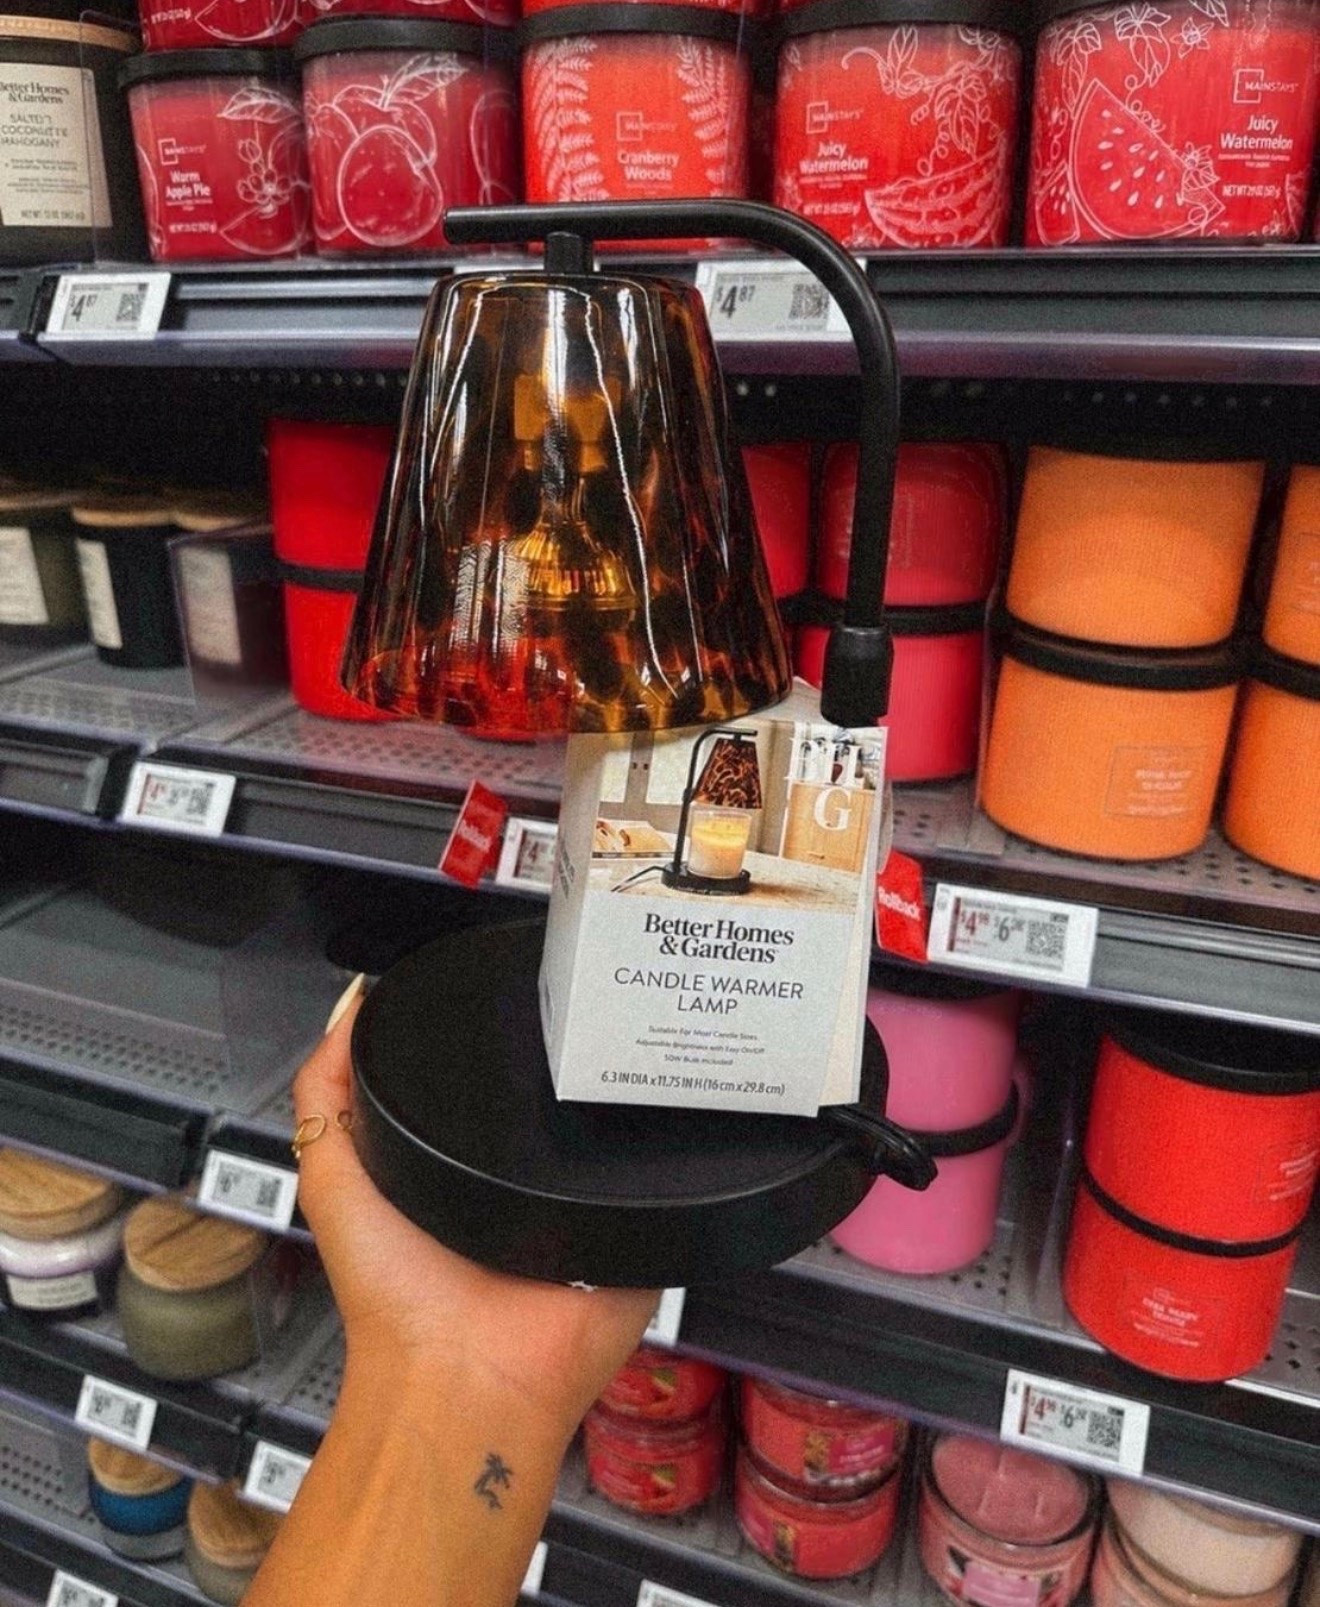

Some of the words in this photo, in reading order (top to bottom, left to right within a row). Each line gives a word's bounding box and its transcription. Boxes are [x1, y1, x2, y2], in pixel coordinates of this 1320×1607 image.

[1247, 114, 1278, 135] Juicy
[818, 140, 847, 159] Juicy
[1220, 133, 1293, 150] Watermelon
[617, 150, 679, 168] Cranberry
[799, 155, 869, 173] Watermelon
[170, 170, 199, 182] Warm
[624, 166, 672, 180] Woods
[165, 185, 191, 199] Apple
[193, 183, 211, 197] Pie
[643, 912, 715, 938] Better
[715, 919, 795, 946] Homes
[659, 935, 678, 956] &
[681, 937, 776, 964] Gardens
[614, 966, 706, 992] CANDLE
[711, 975, 805, 1000] WARMER
[677, 994, 739, 1016] LAMP
[601, 1070, 617, 1084] 6.3
[618, 1072, 630, 1084] IN
[631, 1073, 649, 1086] DIA
[650, 1077, 656, 1087] x
[657, 1075, 681, 1088] 11.75
[682, 1077, 694, 1089] IN
[694, 1077, 703, 1089] H
[703, 1078, 718, 1091] (16
[719, 1081, 735, 1092] cm
[735, 1083, 742, 1092] x
[743, 1081, 764, 1094] 29.8
[765, 1083, 786, 1096] cm)
